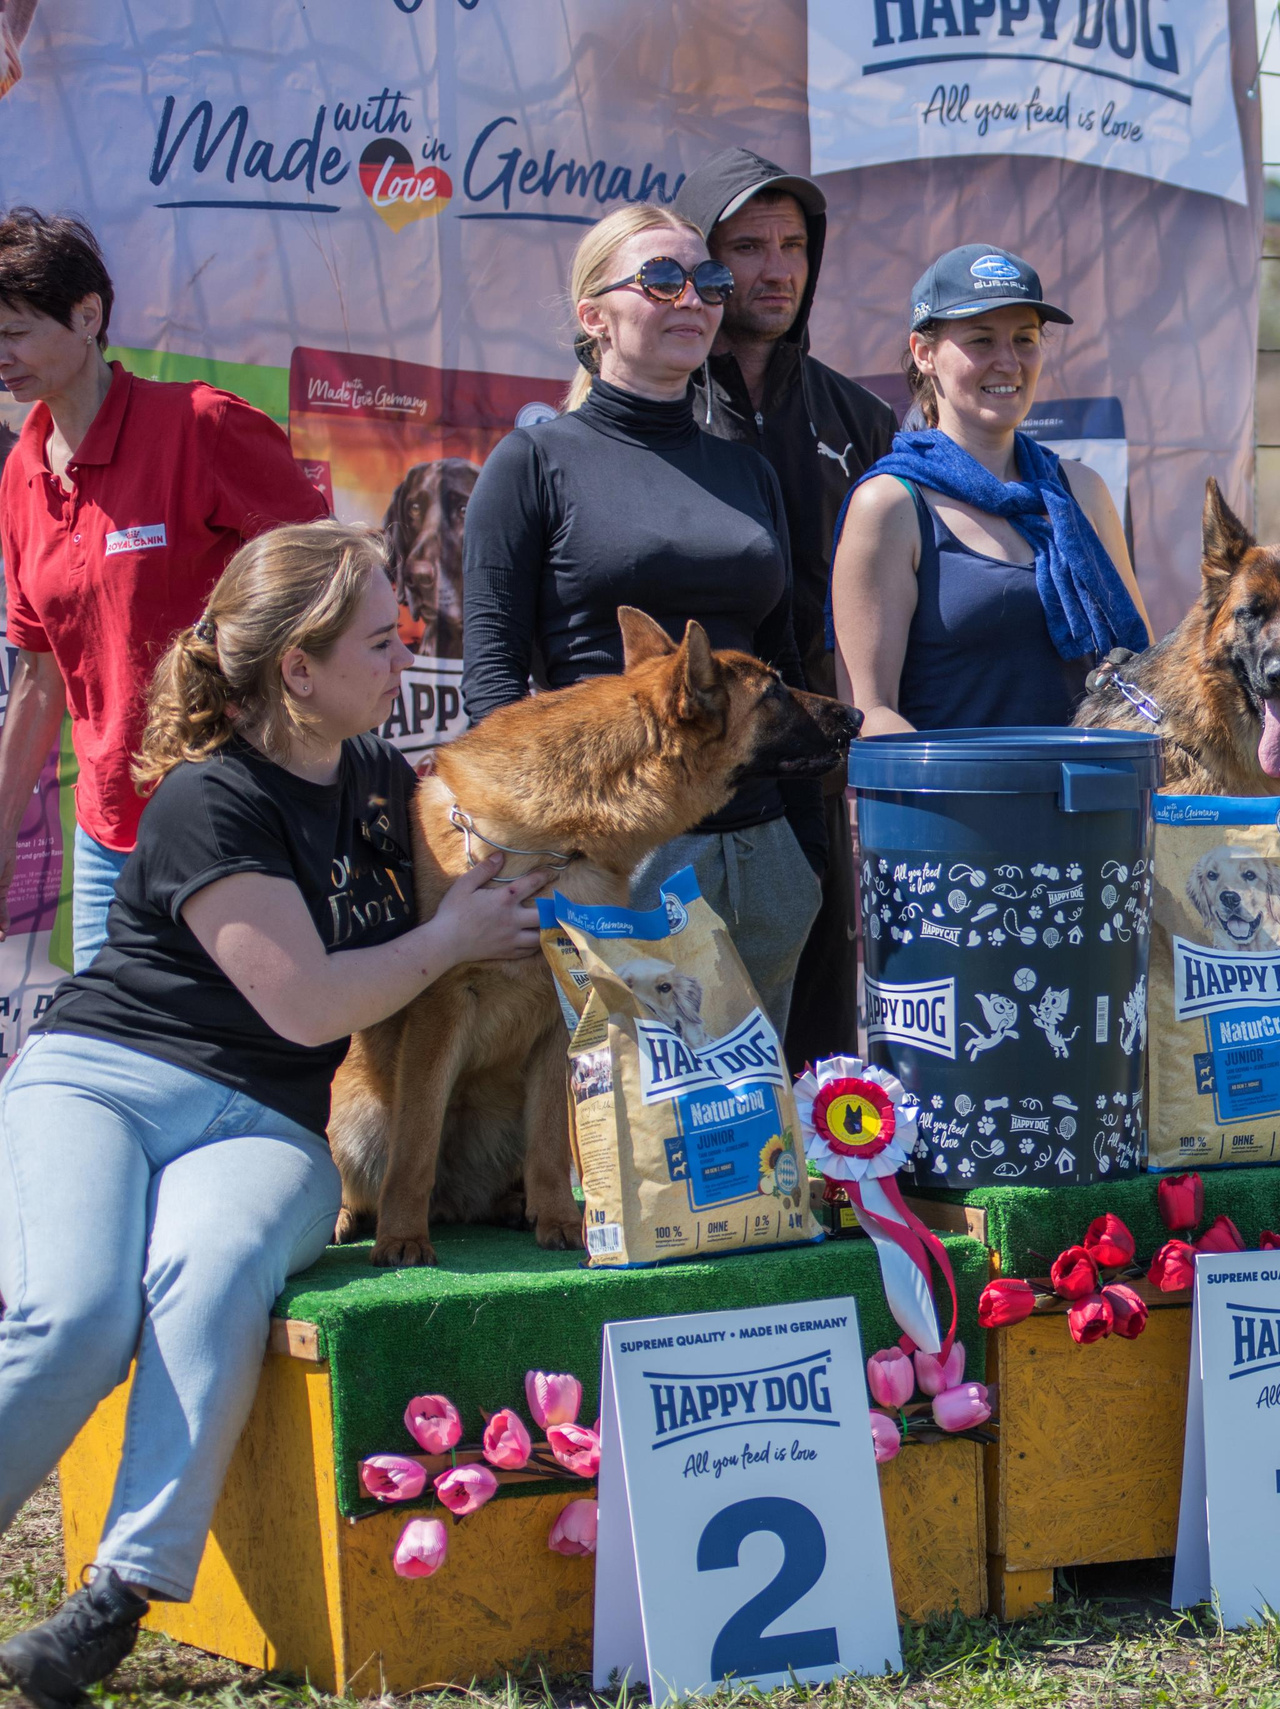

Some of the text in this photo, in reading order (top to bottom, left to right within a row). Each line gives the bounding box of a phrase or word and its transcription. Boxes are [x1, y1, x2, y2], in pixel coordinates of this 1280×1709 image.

[873, 0, 1179, 74] HAPPY DOG
[922, 84, 1143, 142] All you feed is love
[148, 88, 686, 210] Made with Love in German
[973, 280, 1026, 291] SUBARU
[307, 378, 351, 402] Made
[352, 389, 374, 409] Love
[374, 385, 427, 416] Germany
[108, 536, 164, 551] ROYAL CANIN
[370, 683, 461, 739] APP
[1170, 810, 1184, 821] Love
[1184, 805, 1220, 821] Germany
[894, 862, 942, 883] All you feed
[909, 877, 936, 895] is love
[1048, 887, 1084, 905] HAPPY DOG
[596, 917, 634, 934] Germany
[921, 922, 961, 943] HAPPY CAT
[1183, 955, 1267, 1001] HAPPY
[866, 990, 946, 1038] APPY DOG
[714, 1030, 780, 1074] DOG
[1225, 1048, 1264, 1067] JUNIOR
[917, 1112, 970, 1138] All you feed
[1011, 1117, 1049, 1131] HAPPY DOG
[697, 1129, 735, 1150] JUNIOR
[932, 1131, 959, 1149] is love
[1179, 1136, 1207, 1148] 100 %
[1232, 1134, 1255, 1146] OHNE
[595, 1209, 606, 1225] kg
[755, 1215, 770, 1228] 0 %
[789, 1214, 794, 1229] 4
[655, 1226, 683, 1239] 100 %
[707, 1220, 729, 1234] OHNE
[1207, 1271, 1259, 1284] SUPREME
[620, 1316, 848, 1353] SUPREME QUALITY MADE IN GERMANY
[650, 1365, 832, 1436] HAPPY DOG
[683, 1439, 818, 1479] All you feed is love
[696, 1497, 840, 1682] 2
